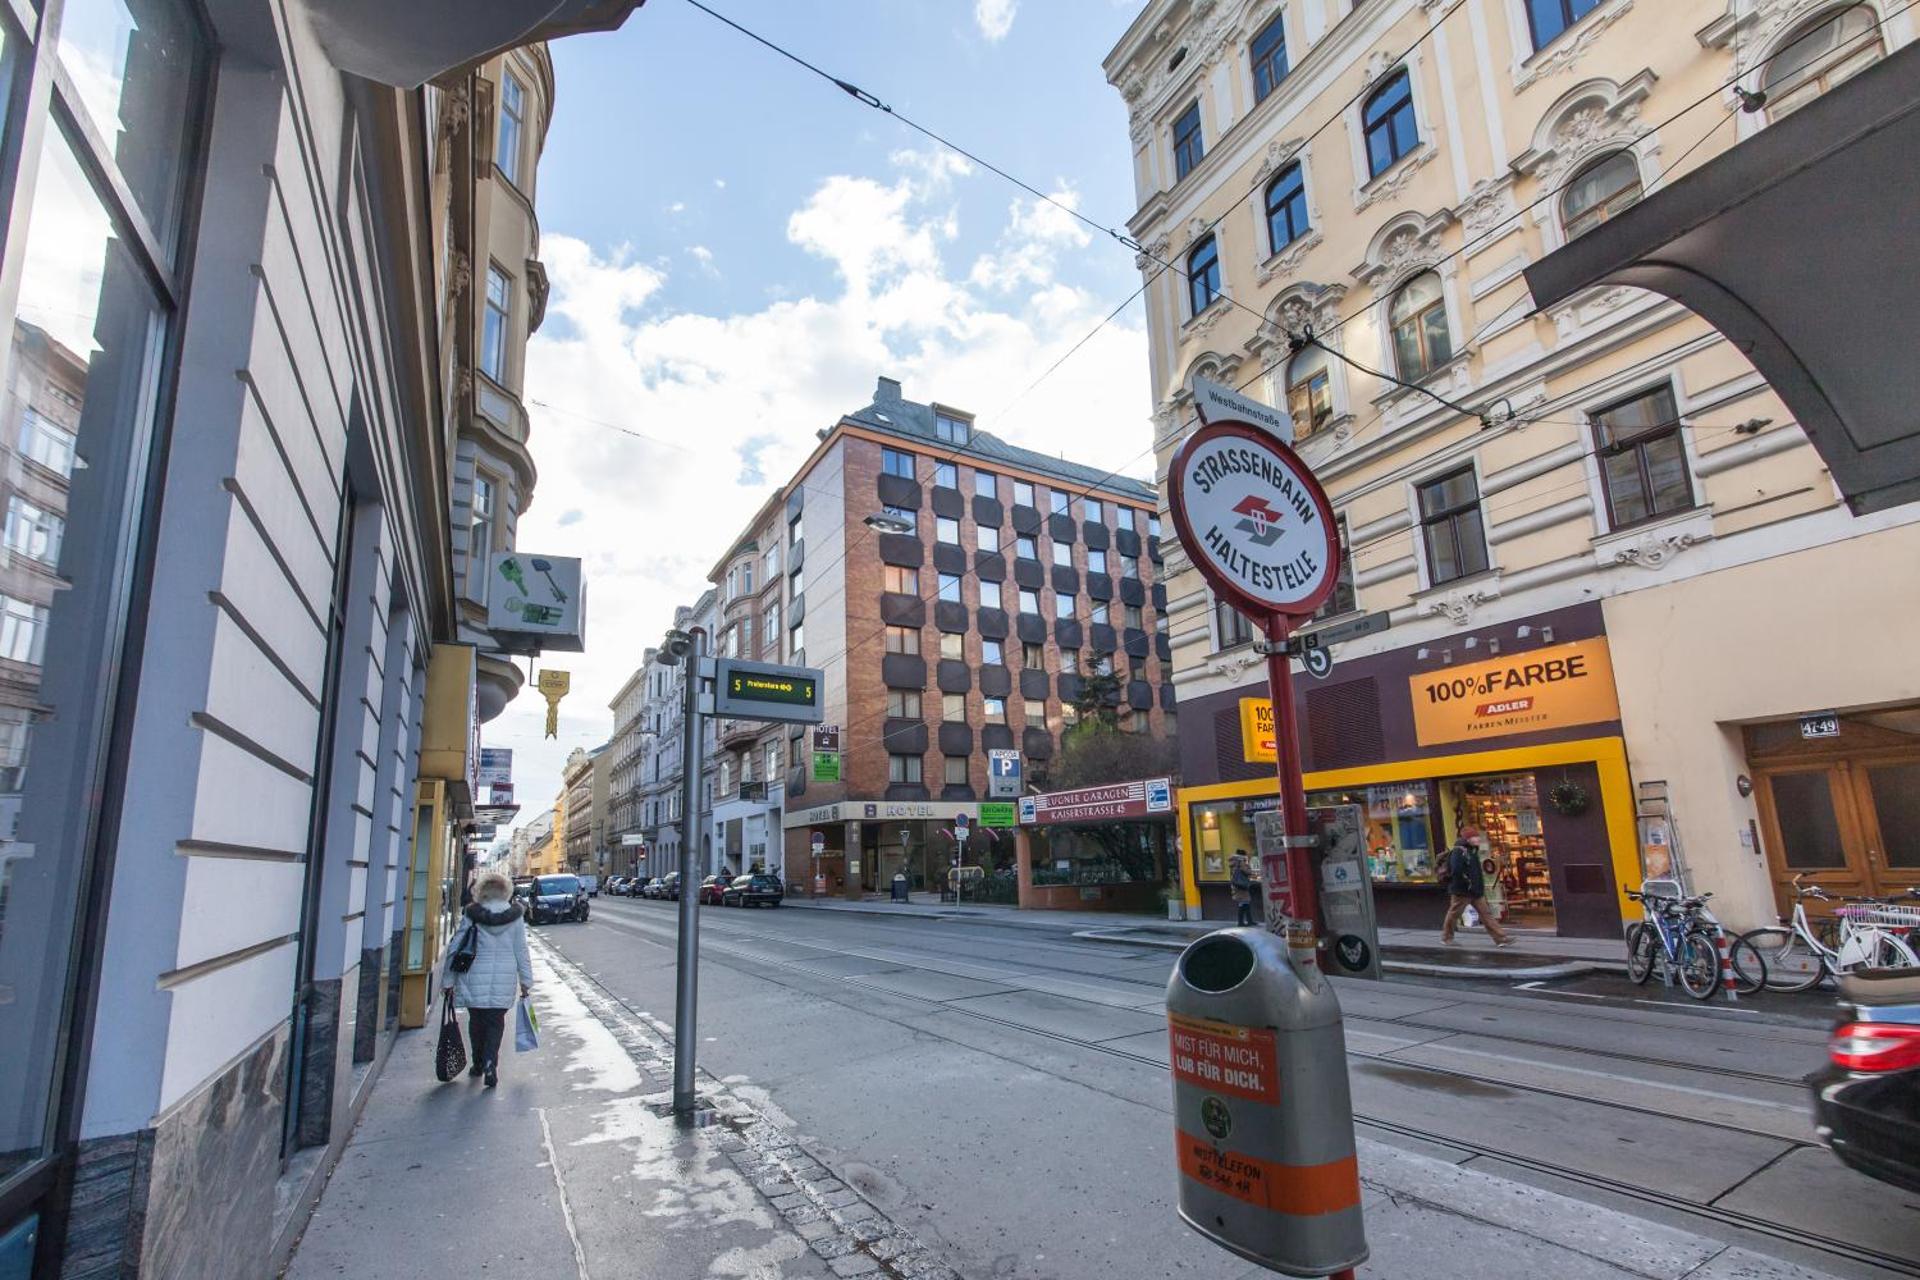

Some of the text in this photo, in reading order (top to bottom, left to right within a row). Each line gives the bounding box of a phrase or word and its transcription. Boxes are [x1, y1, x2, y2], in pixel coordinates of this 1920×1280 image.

[1208, 389, 1280, 427] Westbahnstraße
[1192, 448, 1315, 525] STRASSENBAHN
[1204, 524, 1318, 591] HALTESTELLE
[735, 680, 741, 692] 5
[805, 687, 812, 699] 5
[1487, 700, 1529, 714] ADLER
[813, 724, 839, 734] HOTEL
[1002, 759, 1012, 776] P
[1083, 788, 1130, 802] GARAGEN
[887, 804, 936, 817] HOTEL
[1051, 804, 1115, 820] KAISERSTRASSE
[1174, 1033, 1265, 1071] MIST FÜR MICH,
[1176, 1055, 1265, 1092] LOB FÜR DICH.
